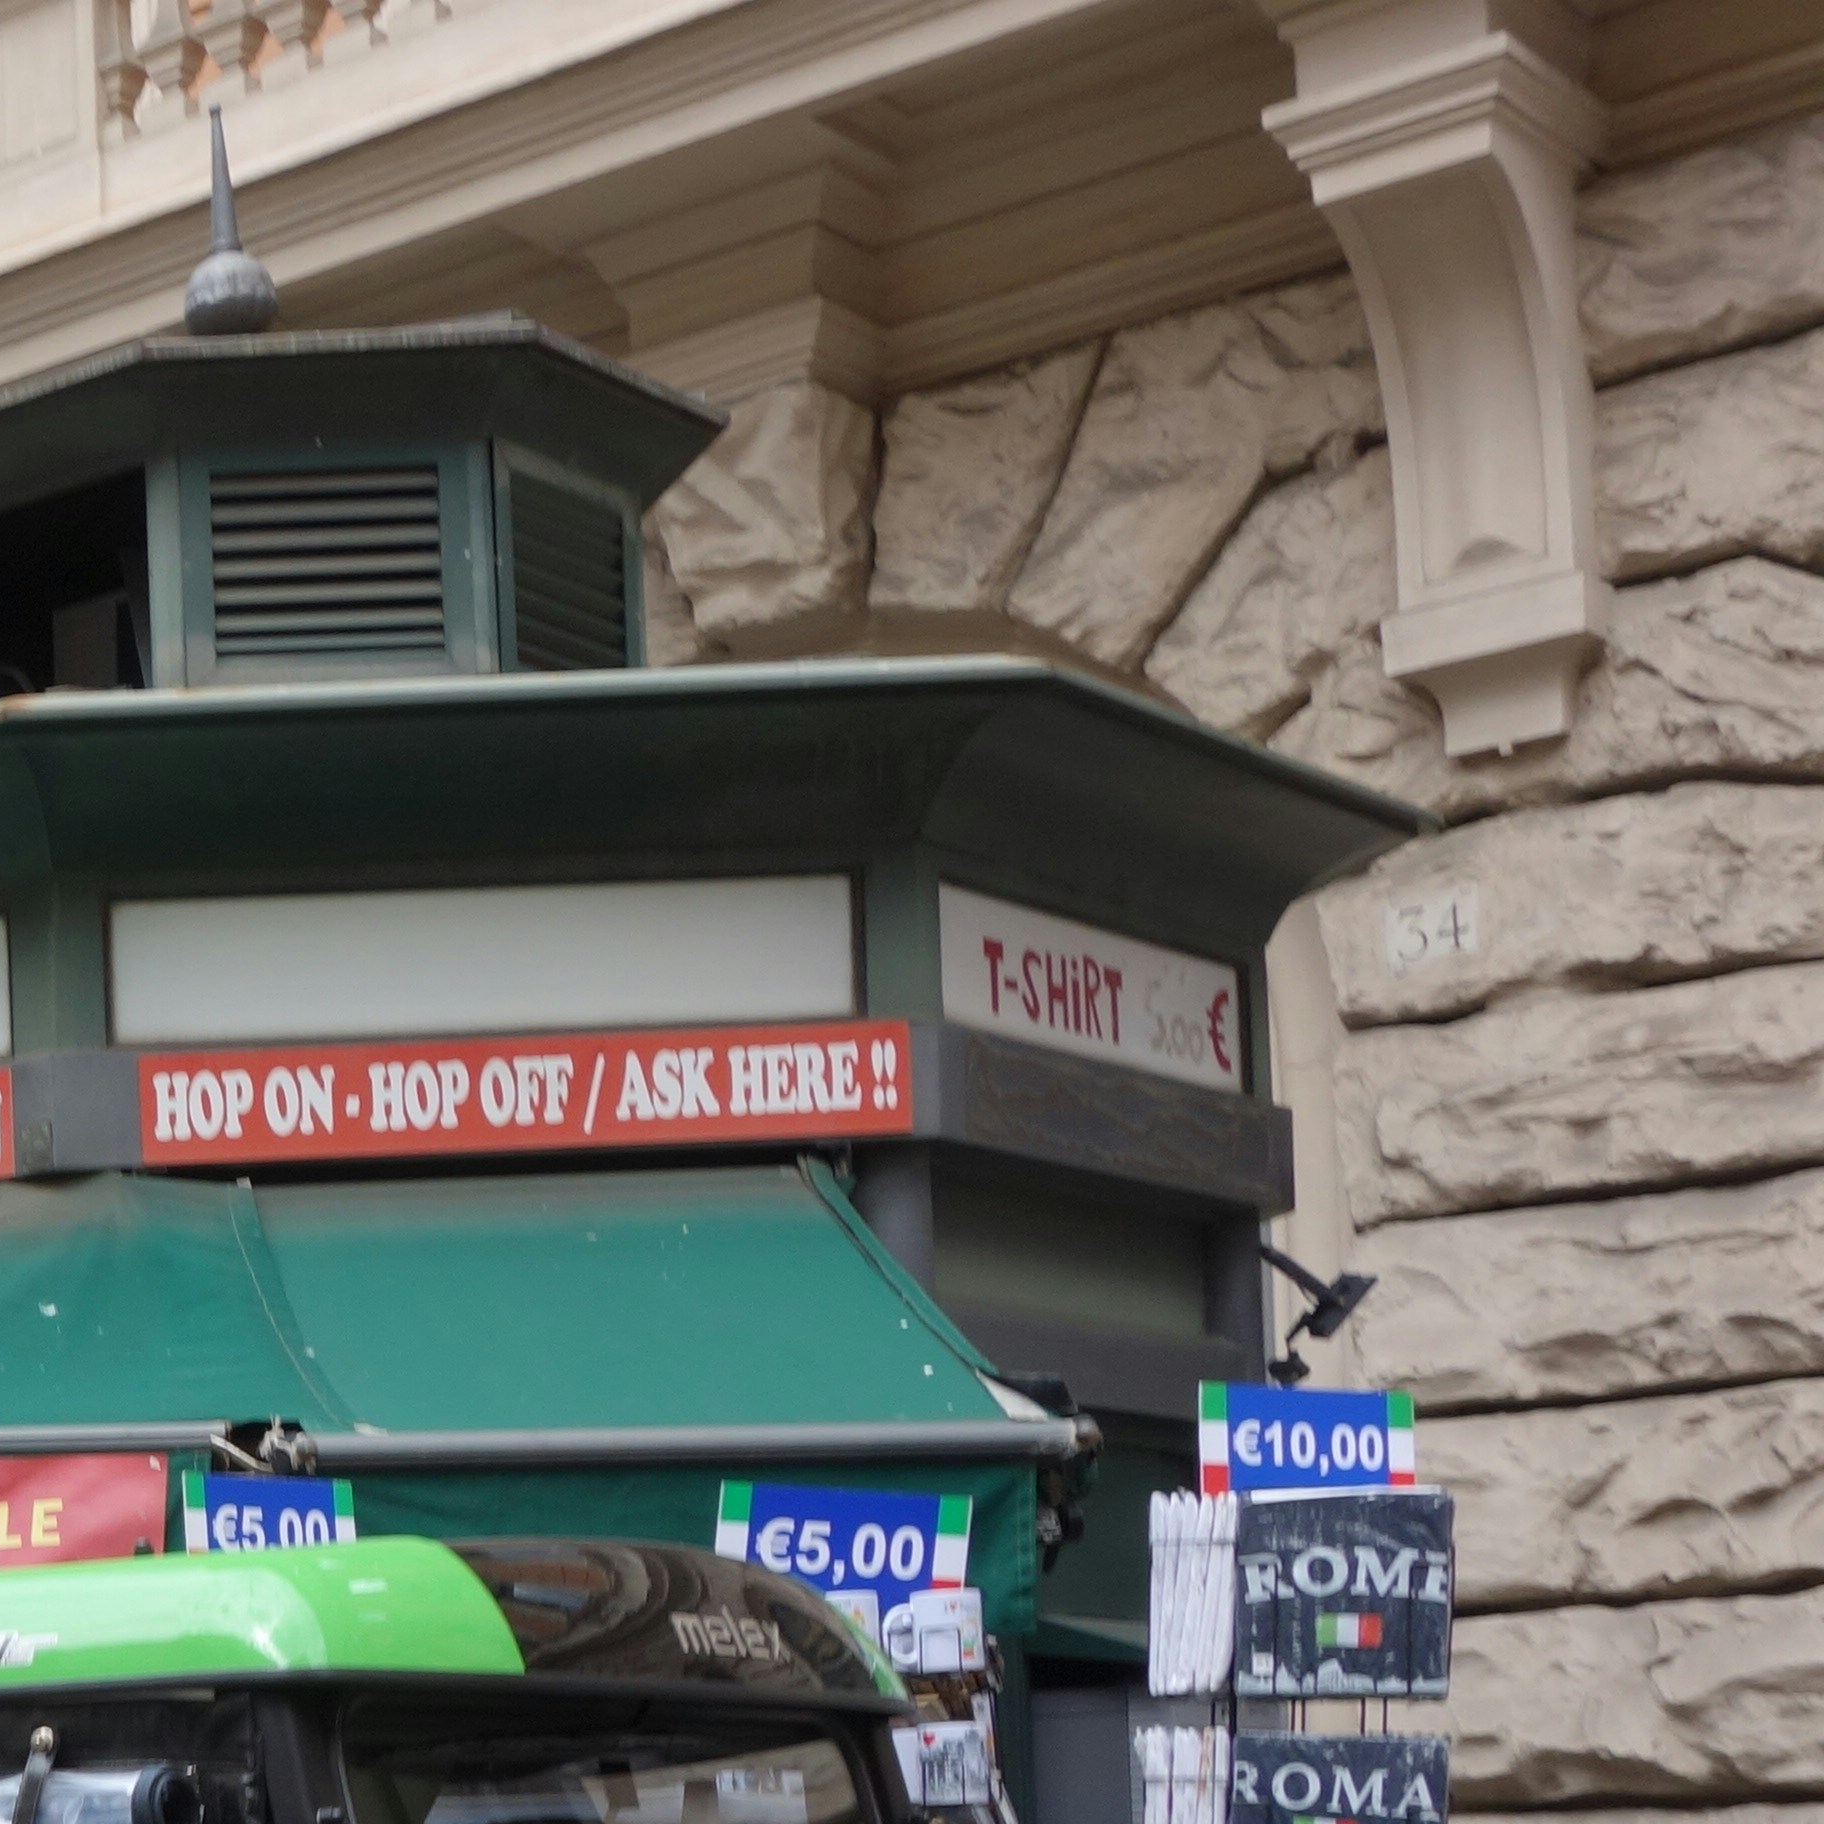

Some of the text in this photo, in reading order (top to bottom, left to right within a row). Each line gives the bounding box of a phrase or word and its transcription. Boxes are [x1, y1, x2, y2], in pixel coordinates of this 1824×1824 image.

[1395, 903, 1471, 962] 34
[153, 1070, 253, 1143] HOP
[263, 1065, 335, 1136] ON
[369, 1060, 469, 1133] HOP
[479, 1052, 575, 1127] OFF
[616, 1046, 721, 1122] ASK
[728, 1039, 864, 1115] HERE
[1233, 1419, 1386, 1480] €10,00
[754, 1516, 927, 1587] €5,00
[670, 1604, 791, 1663] melex
[1234, 1759, 1441, 1823] ROMA
